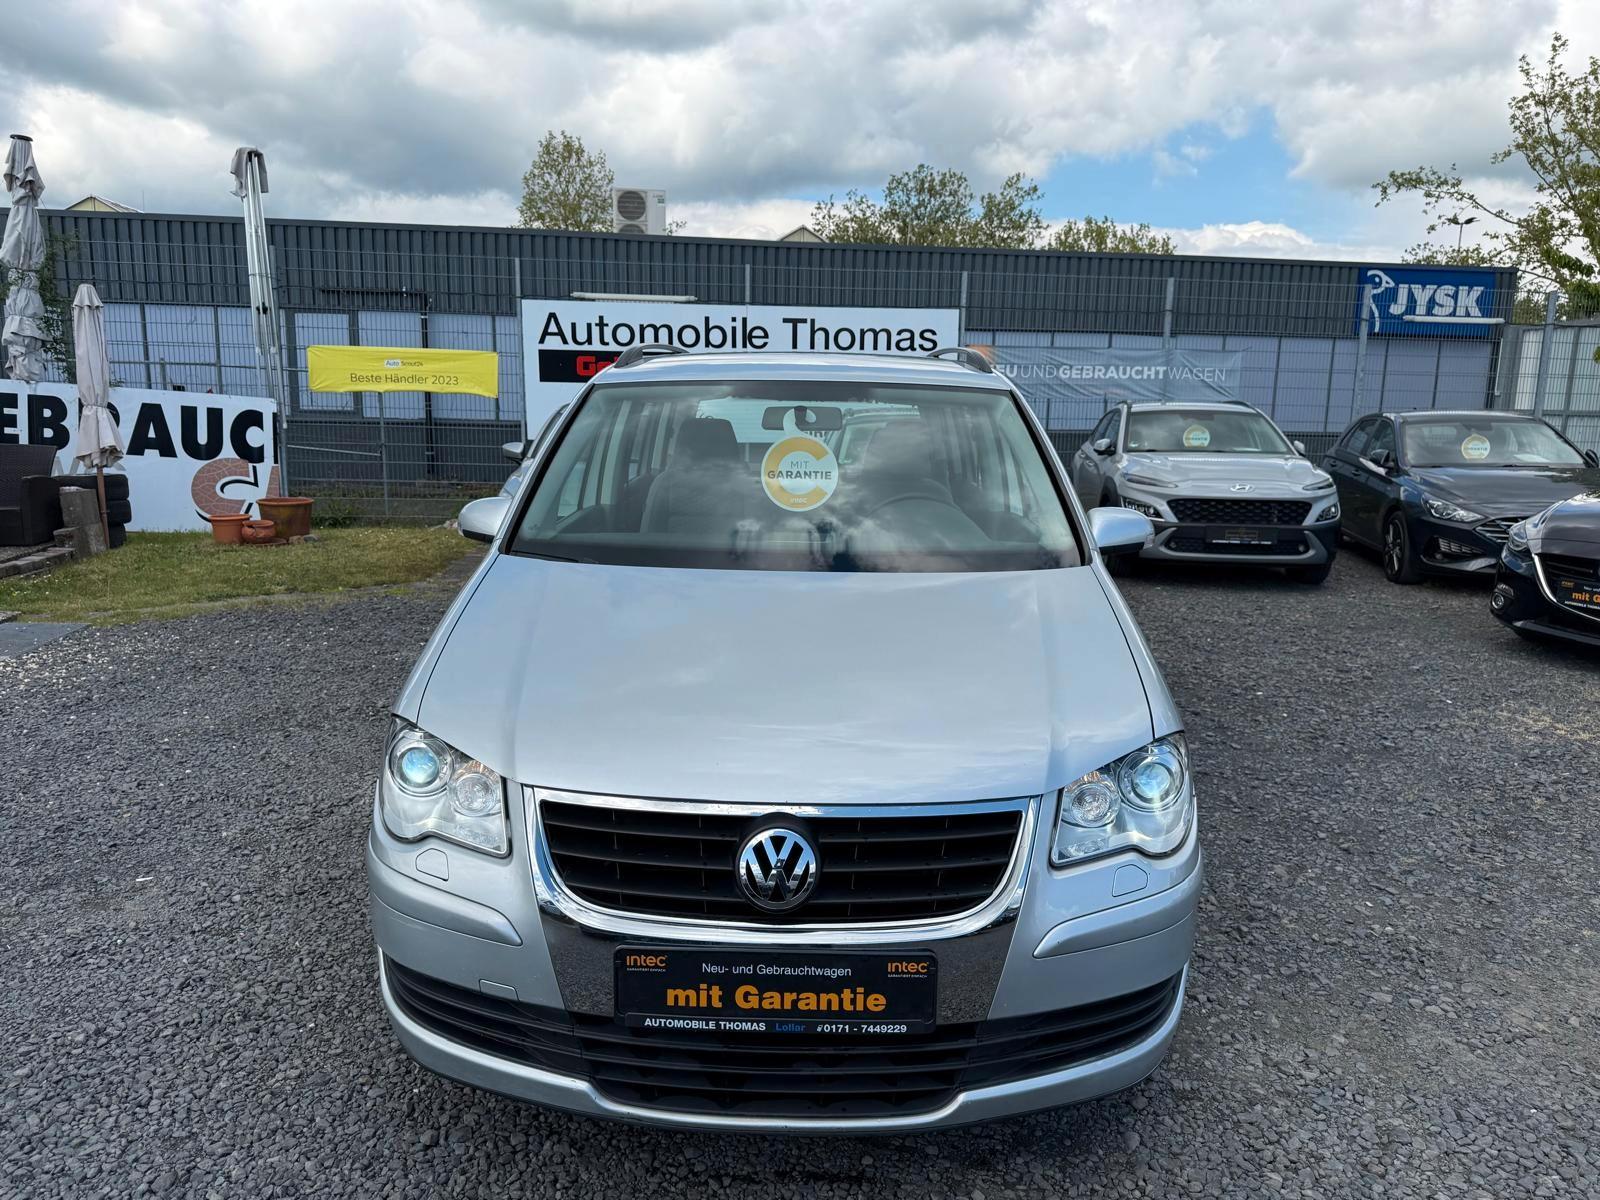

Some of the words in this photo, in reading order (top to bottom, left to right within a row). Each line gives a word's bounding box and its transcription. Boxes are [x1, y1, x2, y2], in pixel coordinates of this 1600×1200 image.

[1389, 284, 1485, 317] JYSK
[538, 312, 769, 349] Automobile
[782, 317, 938, 351] Thomas
[350, 373, 382, 383] Beste
[384, 373, 428, 385] Händler
[432, 375, 459, 386] 2023
[790, 460, 810, 470] MIT
[767, 470, 832, 480] GARANTIE
[626, 955, 667, 967] intec
[887, 962, 929, 973] intec
[702, 963, 729, 974] Neu-
[732, 964, 753, 975] und
[757, 964, 852, 979] Gebrauchtwagen
[666, 983, 723, 1008] mit
[734, 984, 887, 1012] Garantie
[644, 1017, 716, 1030] AUTOMOBILE
[718, 1020, 766, 1031] THOMAS
[824, 1024, 850, 1033] 0171
[861, 1024, 907, 1033] 7449229
